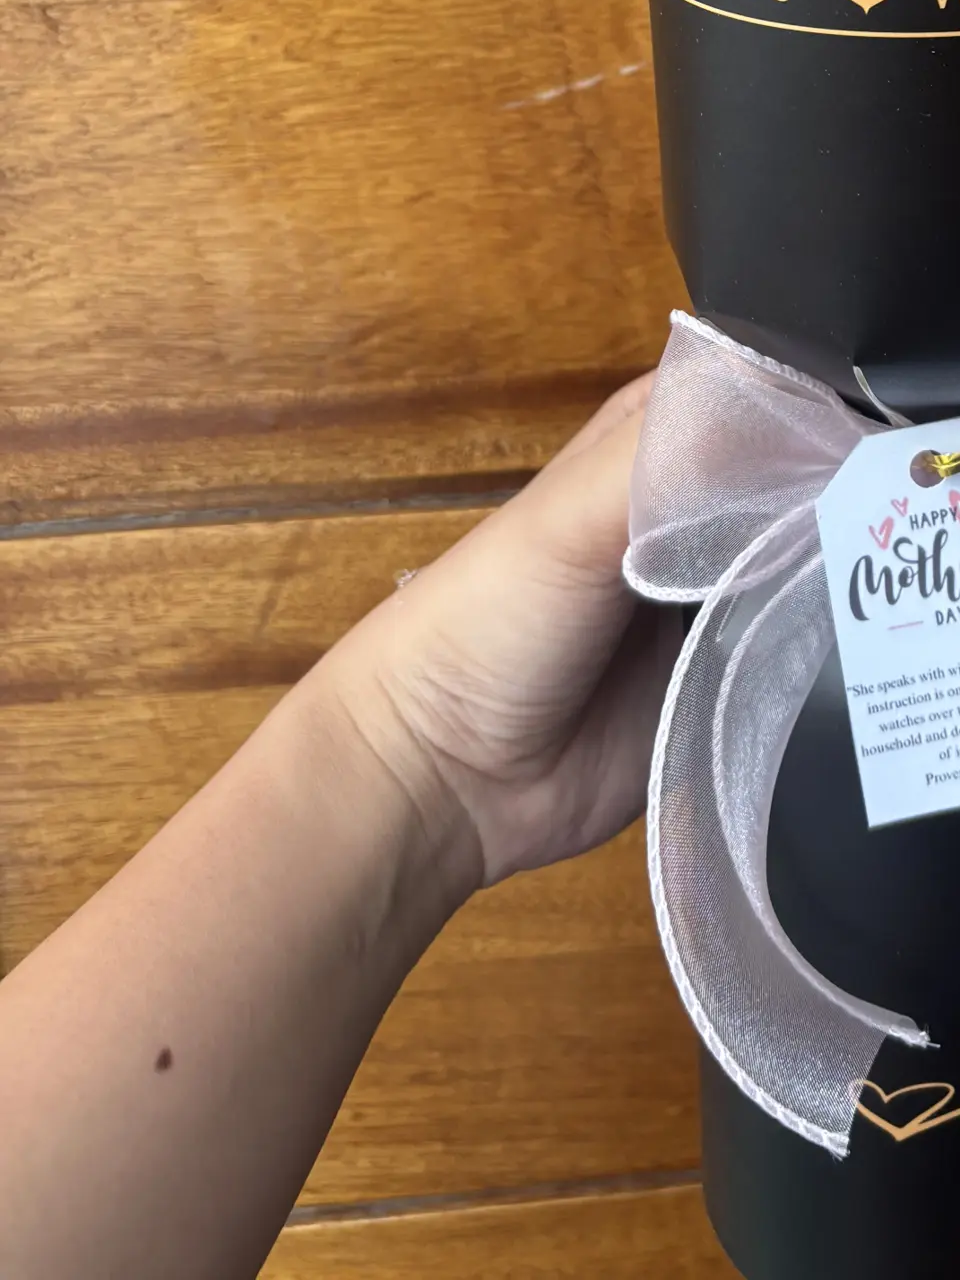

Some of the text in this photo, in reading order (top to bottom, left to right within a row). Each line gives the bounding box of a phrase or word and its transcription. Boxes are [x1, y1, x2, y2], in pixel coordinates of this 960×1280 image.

[909, 507, 958, 531] HAPPY
[877, 674, 916, 694] speaks
[919, 667, 946, 683] with
[867, 691, 932, 715] instruction
[935, 687, 945, 701] is
[879, 714, 926, 733] watches
[928, 708, 954, 722] over
[860, 732, 922, 758] household
[925, 726, 948, 744] and
[939, 745, 953, 761] of
